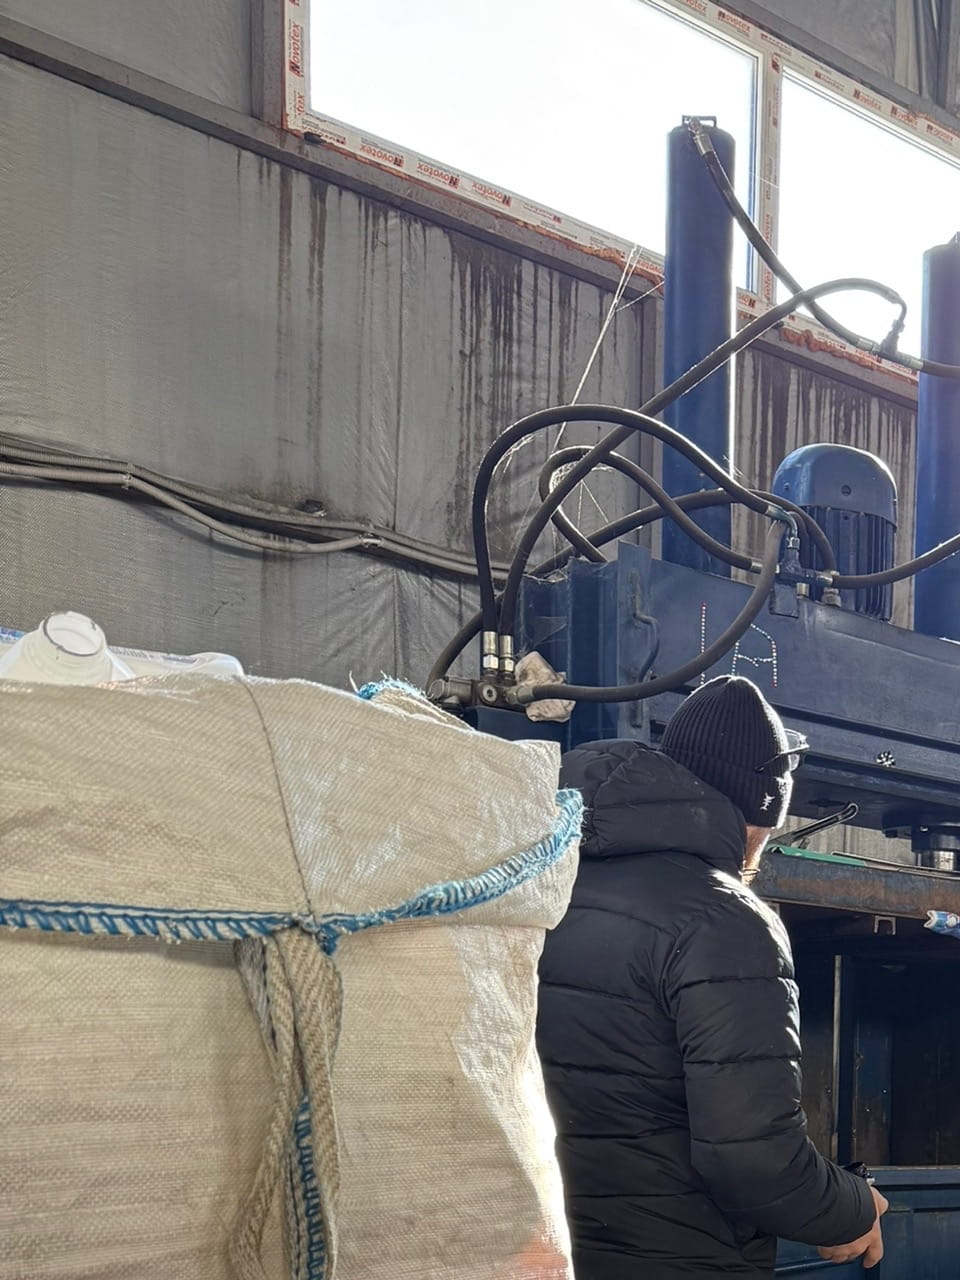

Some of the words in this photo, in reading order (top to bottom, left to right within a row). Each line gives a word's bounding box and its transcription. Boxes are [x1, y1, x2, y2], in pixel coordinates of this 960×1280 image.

[288, 21, 300, 78] Novotex
[360, 144, 405, 168] Novotex
[417, 162, 460, 189] Novotex
[472, 180, 512, 207] Novotex
[637, 260, 664, 274] ovotex
